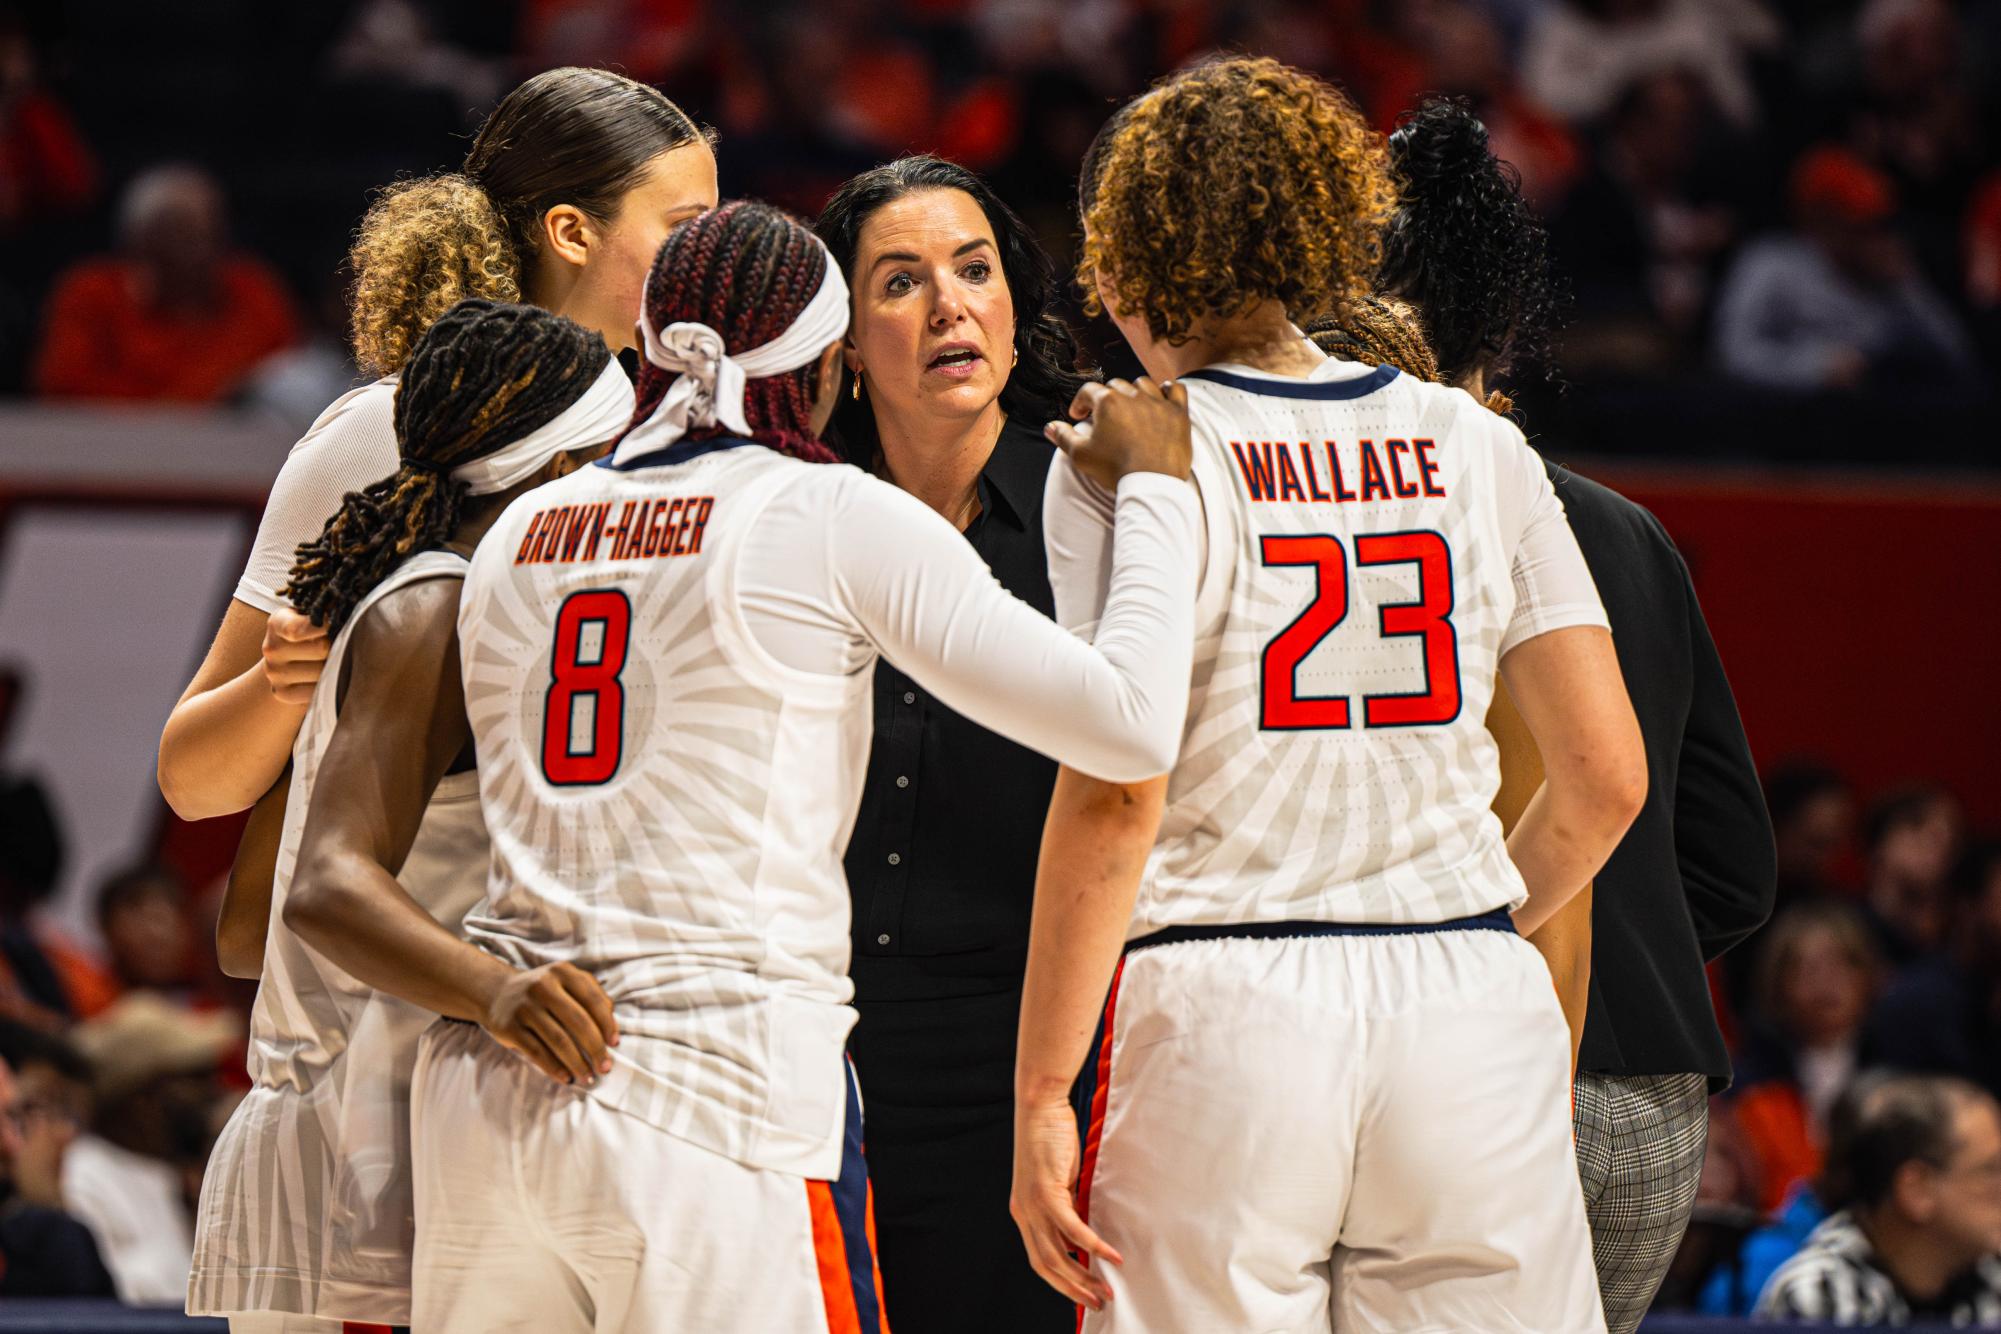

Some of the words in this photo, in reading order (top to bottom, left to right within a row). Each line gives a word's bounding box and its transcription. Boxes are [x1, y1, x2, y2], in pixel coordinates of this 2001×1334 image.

[514, 496, 715, 567] BROWN-HAGGER
[1230, 438, 1447, 503] WALLACE
[541, 587, 632, 787] 8
[1259, 529, 1462, 731] 23
